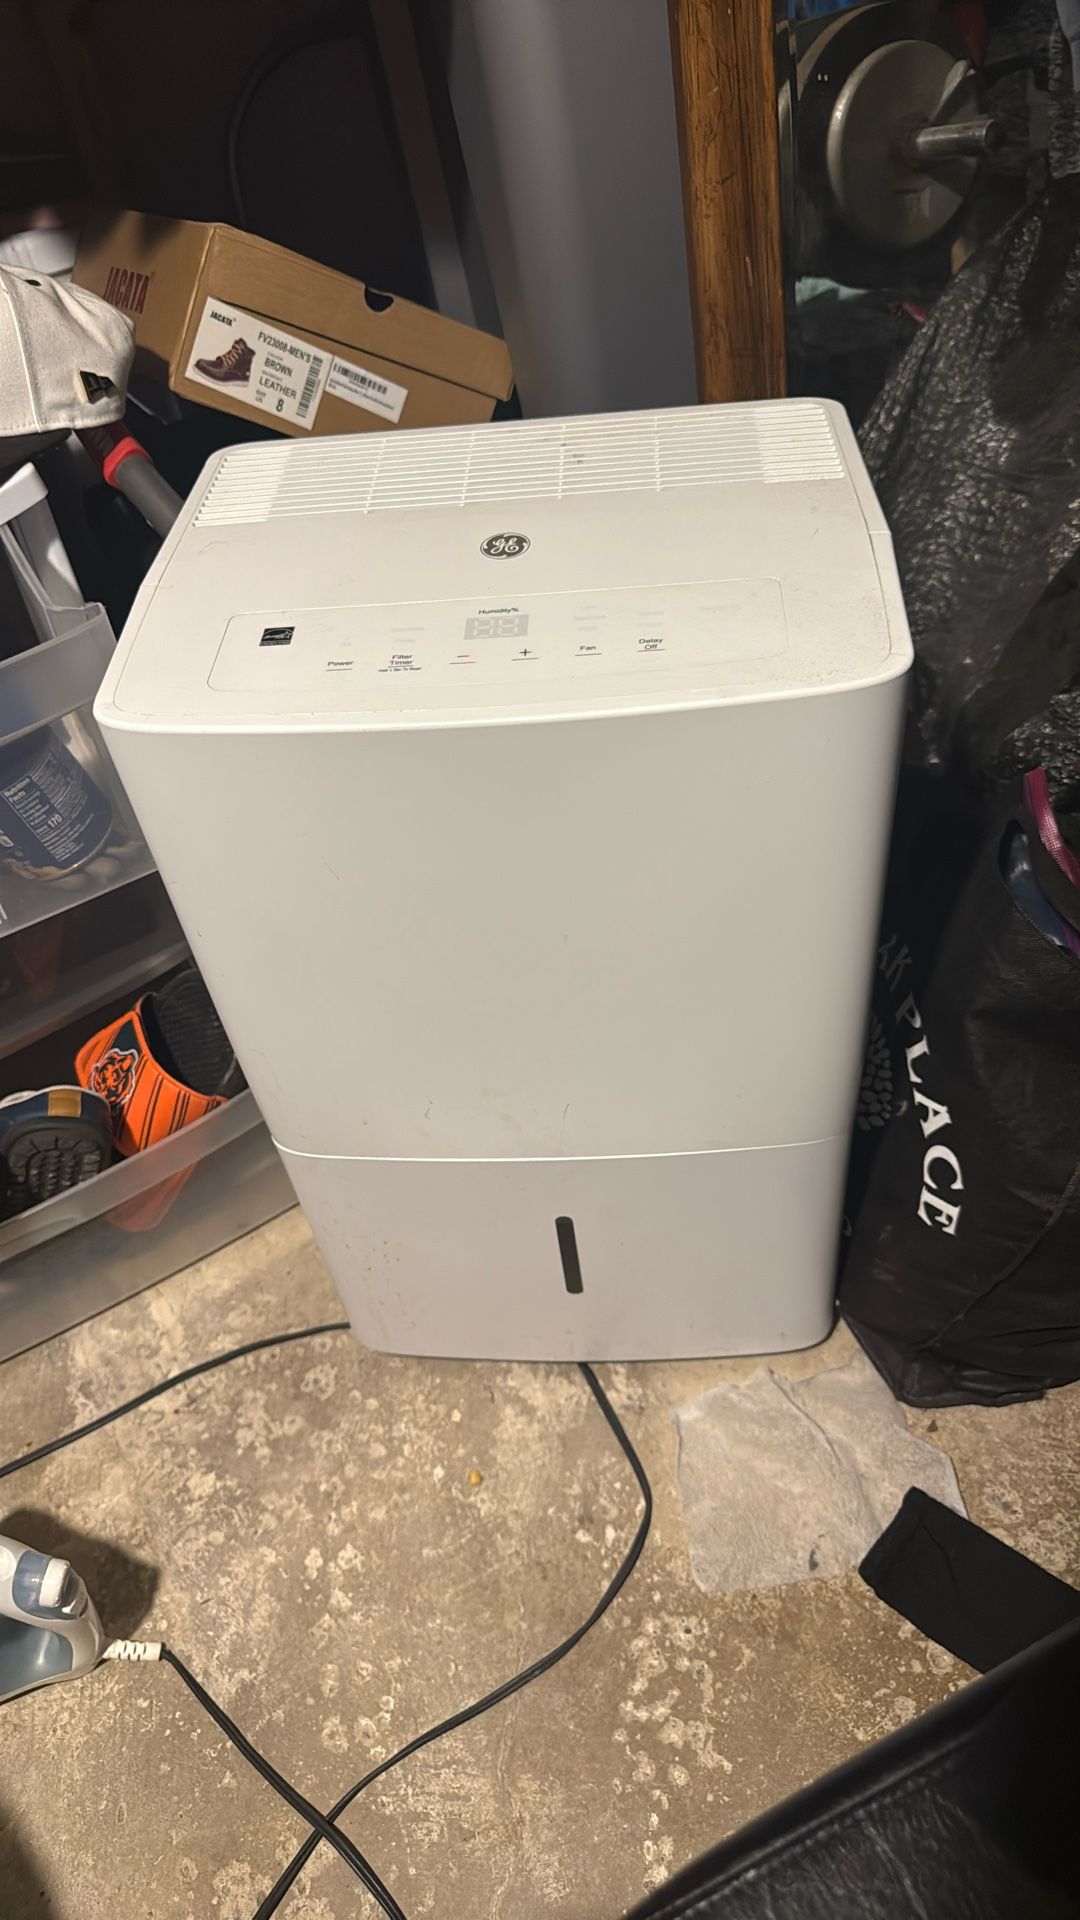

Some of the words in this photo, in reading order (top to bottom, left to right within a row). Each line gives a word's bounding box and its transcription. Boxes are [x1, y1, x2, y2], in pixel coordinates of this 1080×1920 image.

[209, 310, 234, 327] JACATA
[264, 357, 294, 377] BROWN
[258, 376, 298, 400] LEATHER
[275, 398, 285, 412] 8
[478, 607, 520, 615] Humidity%
[638, 637, 664, 645] Delay
[47, 813, 63, 829] 170
[896, 991, 965, 1237] PLACE
